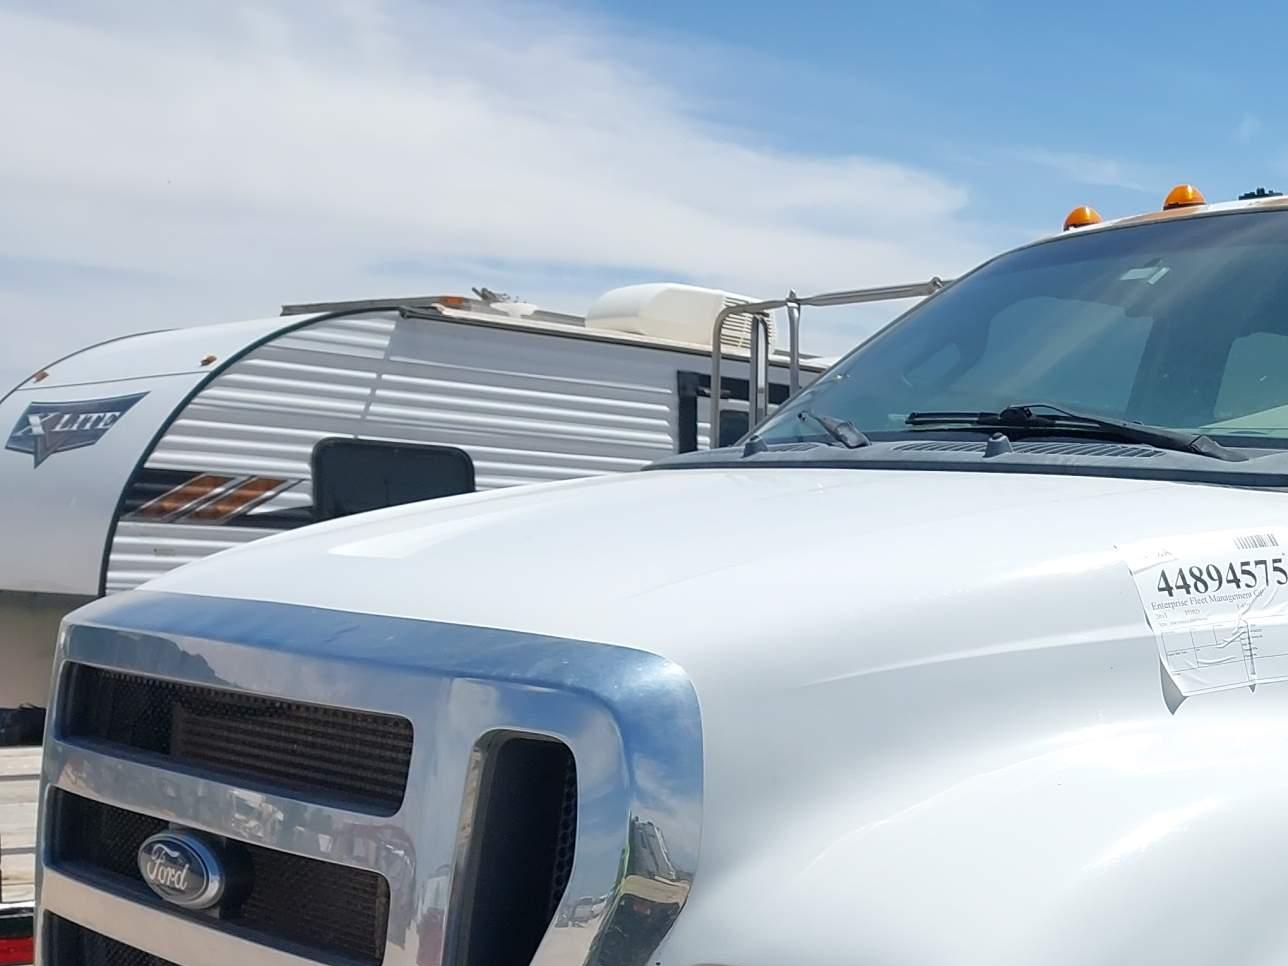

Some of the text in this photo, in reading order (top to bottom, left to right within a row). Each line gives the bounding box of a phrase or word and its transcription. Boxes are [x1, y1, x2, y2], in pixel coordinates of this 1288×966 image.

[1157, 558, 1288, 597] 44894575
[1151, 600, 1188, 610] Enterprise
[1189, 597, 1208, 605] Fleet
[1208, 591, 1252, 602] Management
[146, 843, 190, 890] Ford
